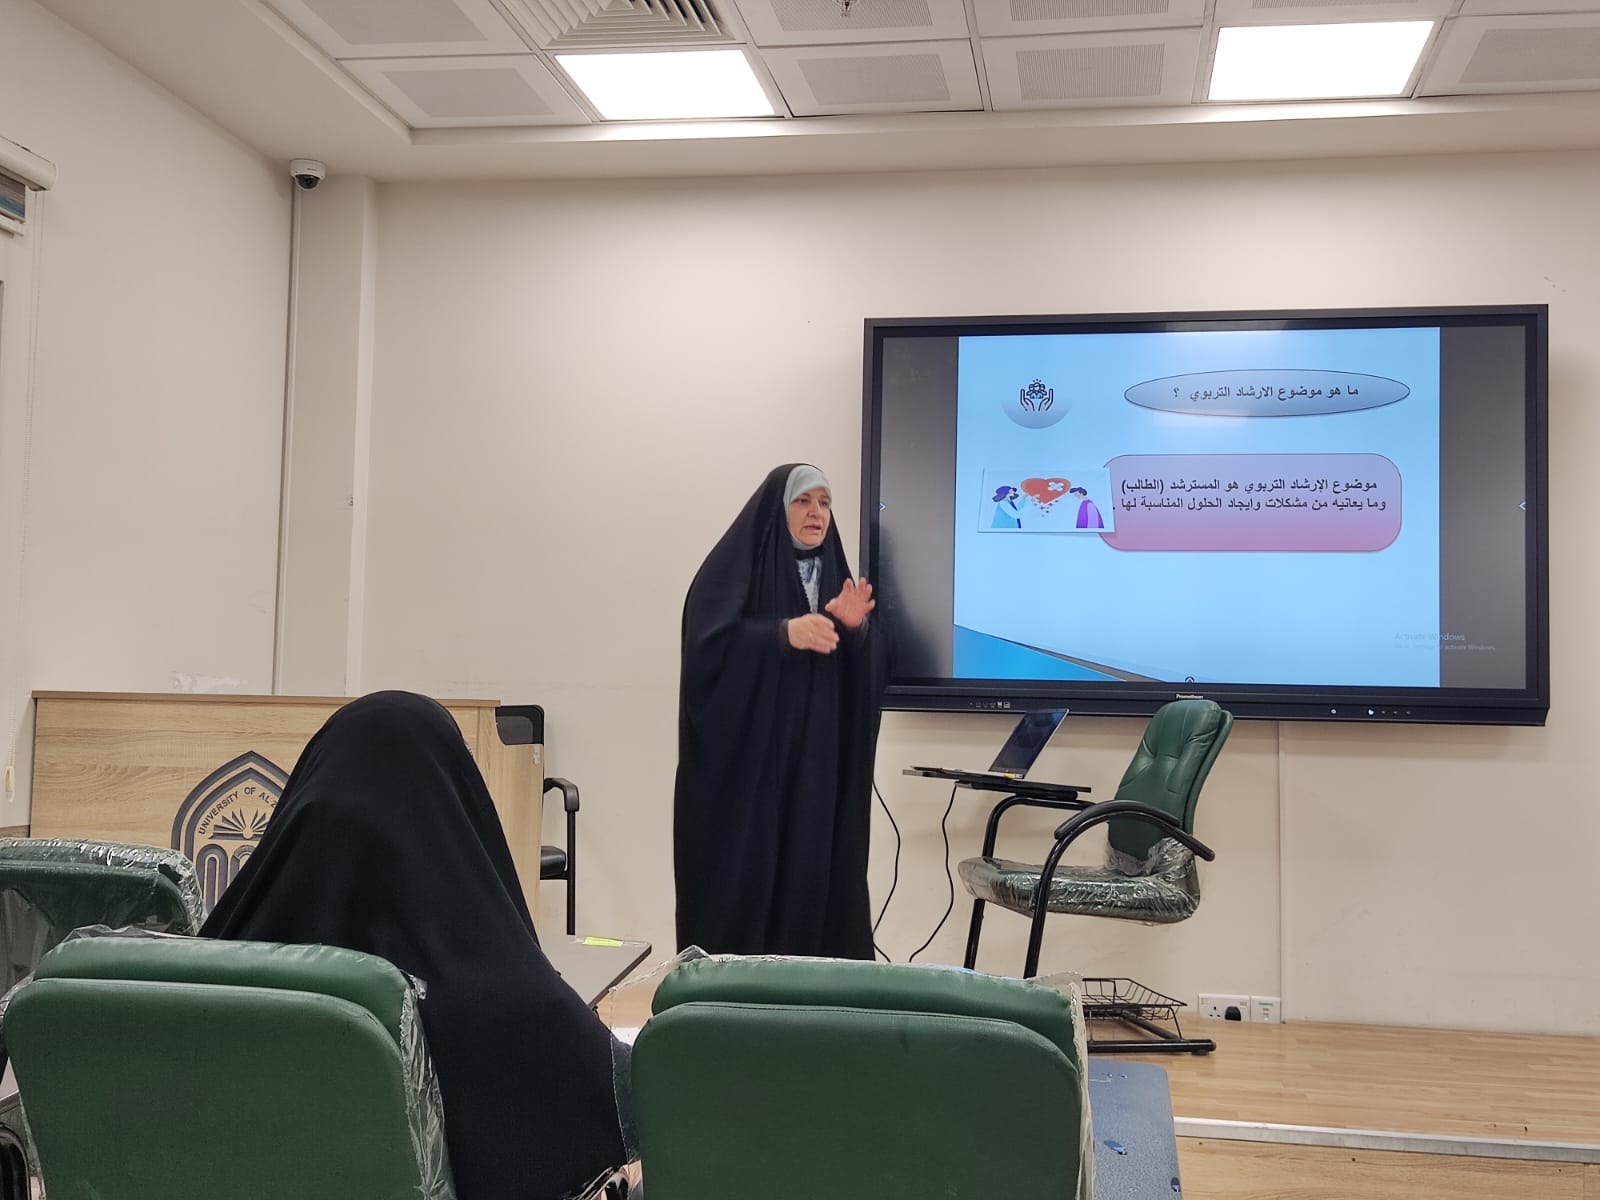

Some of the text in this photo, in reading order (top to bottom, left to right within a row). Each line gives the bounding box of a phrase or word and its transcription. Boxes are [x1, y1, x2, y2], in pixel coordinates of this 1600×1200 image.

[1190, 386, 1230, 402] التربوي
[1236, 385, 1273, 399] الارشاد
[1278, 384, 1322, 401] موضوع
[1326, 387, 1341, 398] هو
[1346, 385, 1359, 396] ما
[1121, 478, 1377, 495] موضوع الإرشاد التربوي هو المسترشد (الطالب)
[1121, 497, 1137, 511] لها
[1140, 496, 1183, 511] المناسبة
[1187, 498, 1222, 511] الحلول
[1227, 498, 1261, 511] وايجاد
[1265, 497, 1308, 508] مشكلات
[1311, 499, 1328, 511] من
[1332, 497, 1363, 511] يعانيه
[1366, 497, 1387, 511] وما
[198, 791, 239, 835] UNIVERSITY
[244, 787, 256, 795] OF
[258, 792, 270, 804] AL
